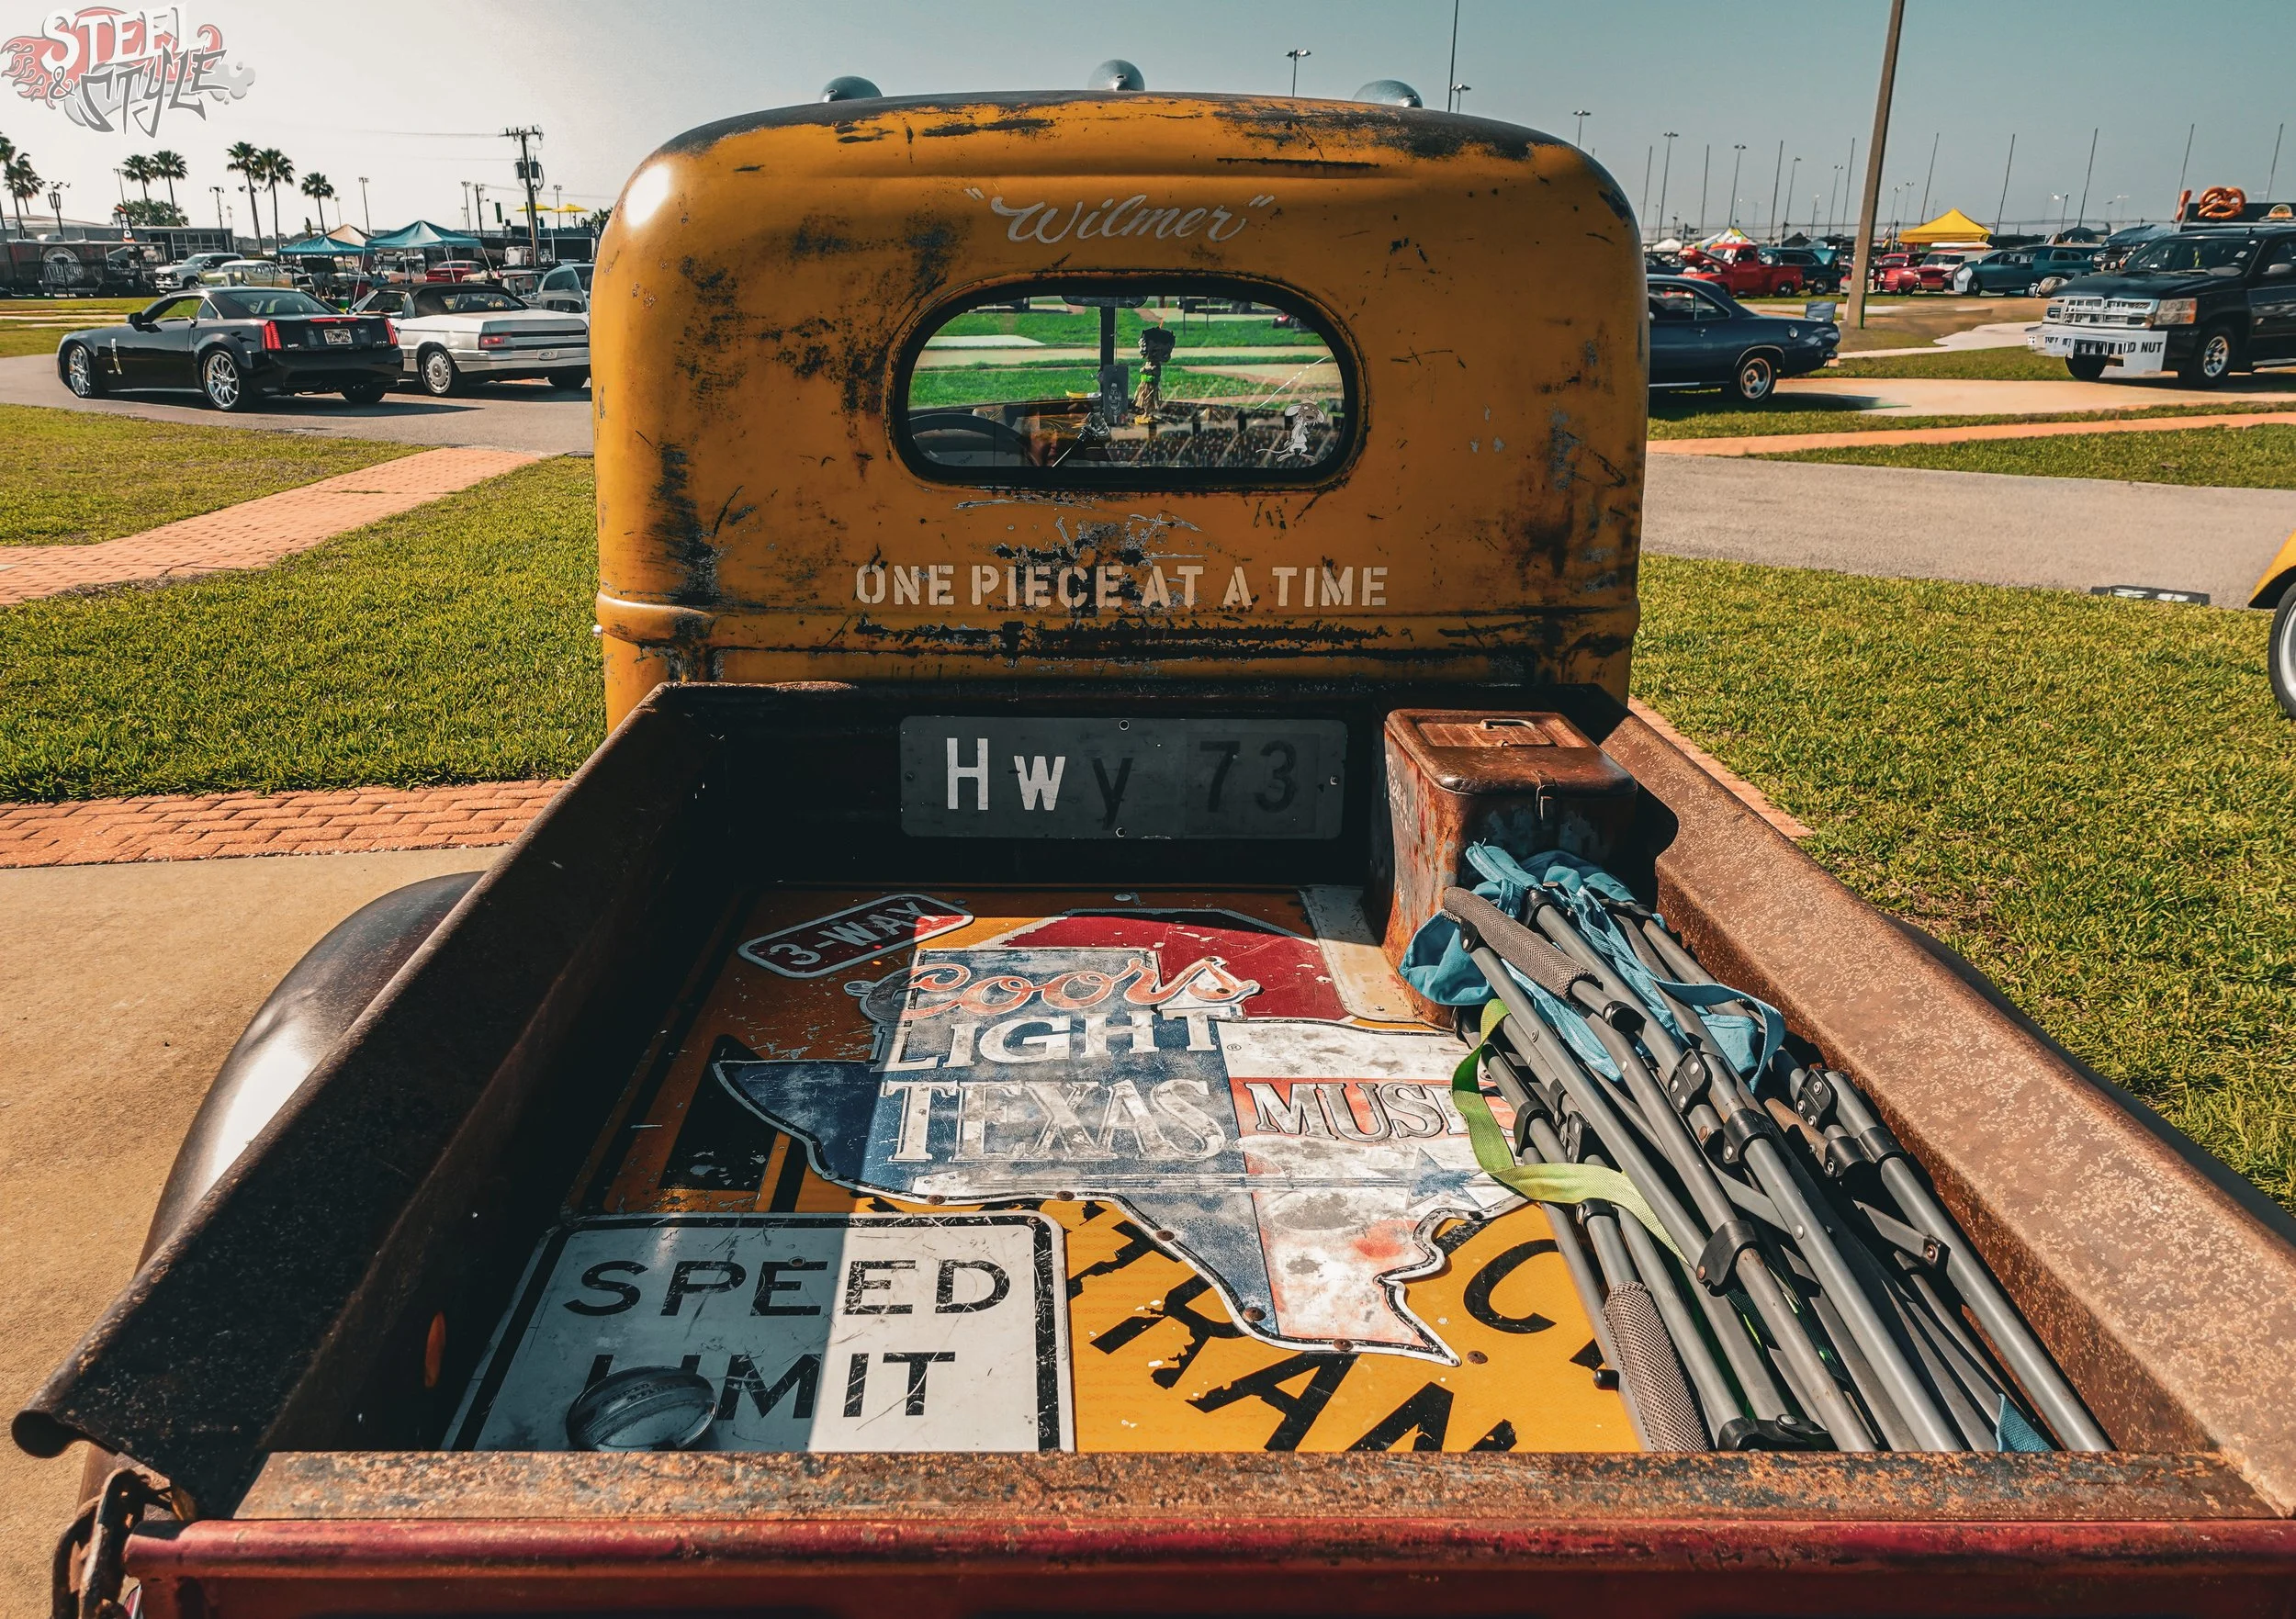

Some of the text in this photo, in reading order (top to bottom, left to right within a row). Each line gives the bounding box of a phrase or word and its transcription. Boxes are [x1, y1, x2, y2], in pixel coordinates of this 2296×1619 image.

[2140, 342, 2163, 354] NUT
[855, 563, 1389, 608] ONE PIECE AT A TIME
[946, 736, 1133, 830] Hwy
[1199, 739, 1299, 814] 73
[769, 901, 940, 965] 3-WAY
[864, 957, 1260, 1019] Coors
[871, 1007, 1232, 1073] LIGHT
[880, 1078, 1514, 1164] TEXAS MUSI
[563, 1259, 1013, 1317] SPEED
